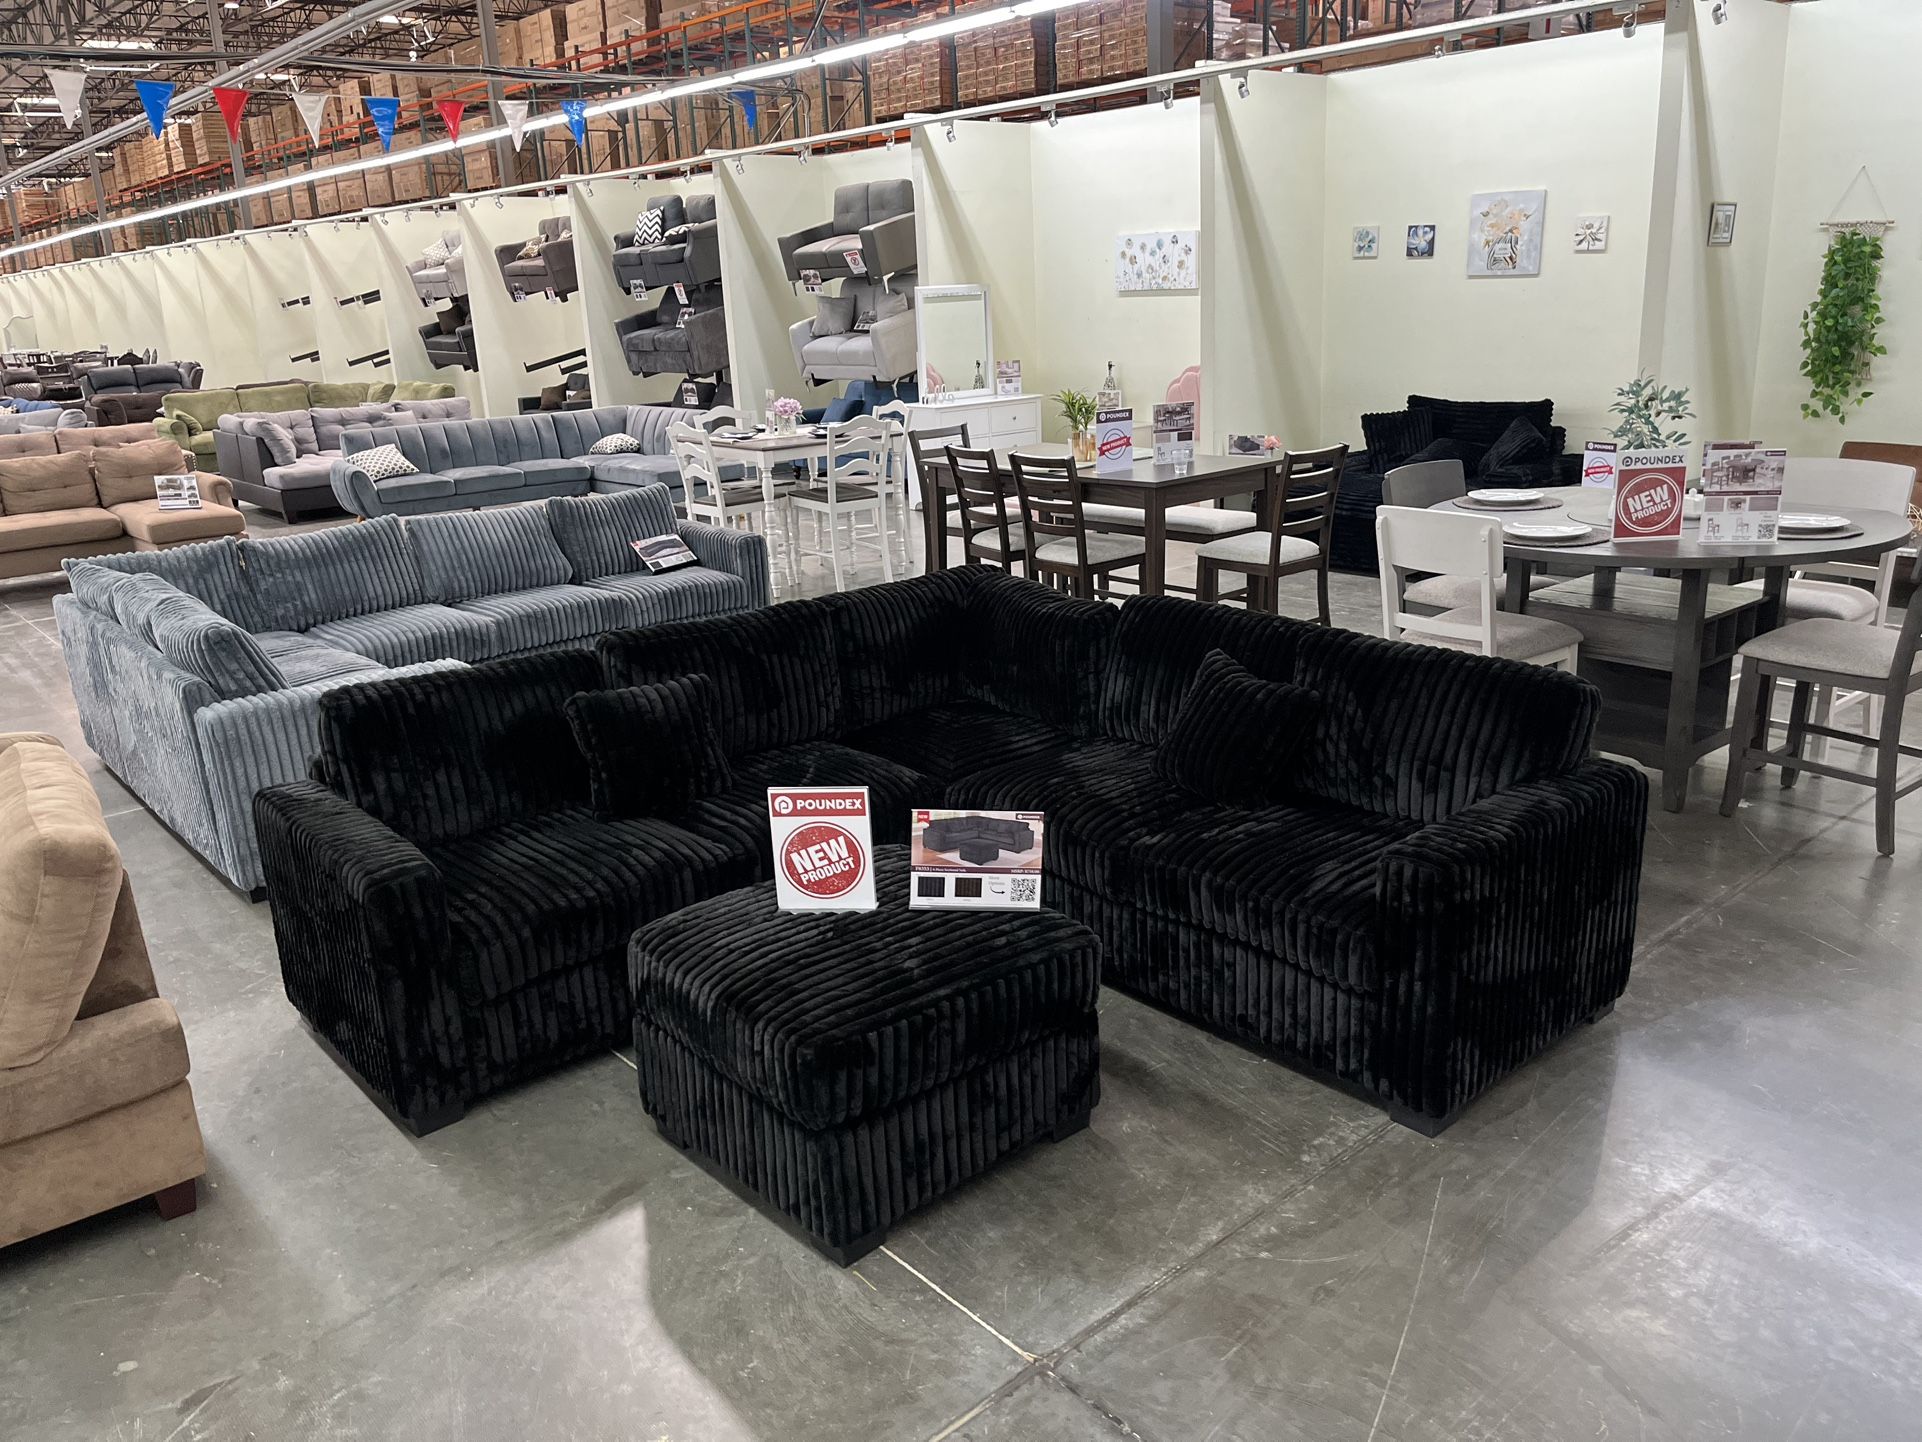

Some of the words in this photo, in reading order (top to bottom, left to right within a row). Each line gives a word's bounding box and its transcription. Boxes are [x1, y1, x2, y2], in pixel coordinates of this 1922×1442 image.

[1101, 443, 1111, 451] NEW
[1111, 438, 1128, 448] PRODUCT
[1633, 455, 1684, 466] POUNDEX
[1626, 484, 1669, 513] NEW
[1631, 499, 1672, 521] PRODUCT
[796, 799, 862, 810] POUNDEX
[790, 835, 850, 874] NEW
[800, 857, 855, 884] PRODUCT
